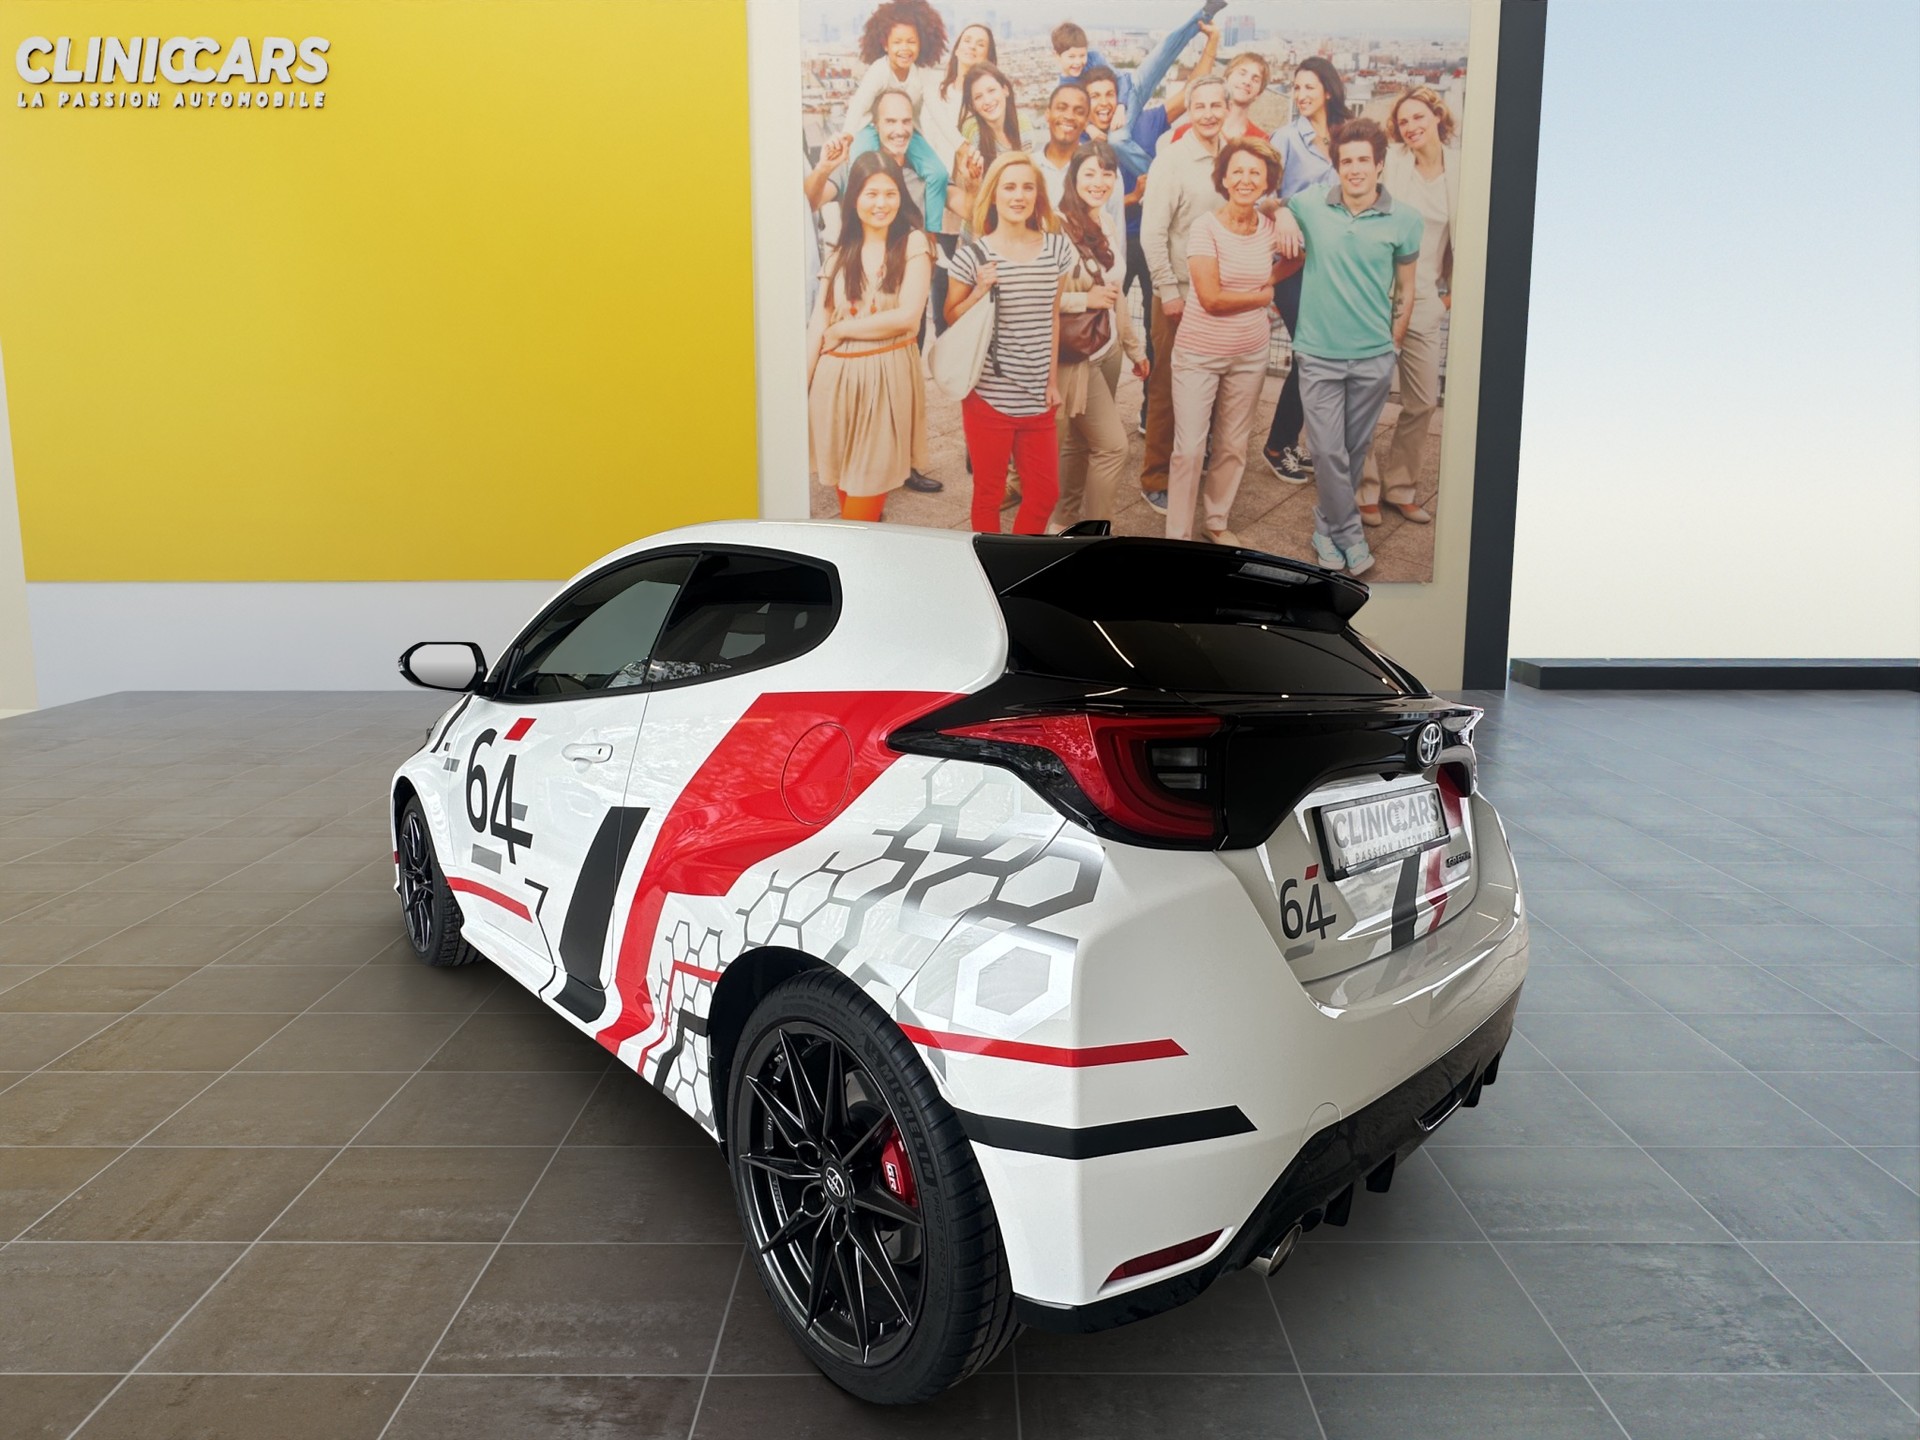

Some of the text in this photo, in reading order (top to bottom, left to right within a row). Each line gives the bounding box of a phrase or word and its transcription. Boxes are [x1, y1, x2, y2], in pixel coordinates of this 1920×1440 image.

[16, 91, 327, 109] LA PASSION AUTOMOBILE
[466, 728, 533, 865] 64
[1356, 845, 1393, 863] PASSION
[1279, 879, 1336, 940] 64
[880, 1063, 935, 1180] MICHELIN
[886, 1164, 898, 1191] GR
